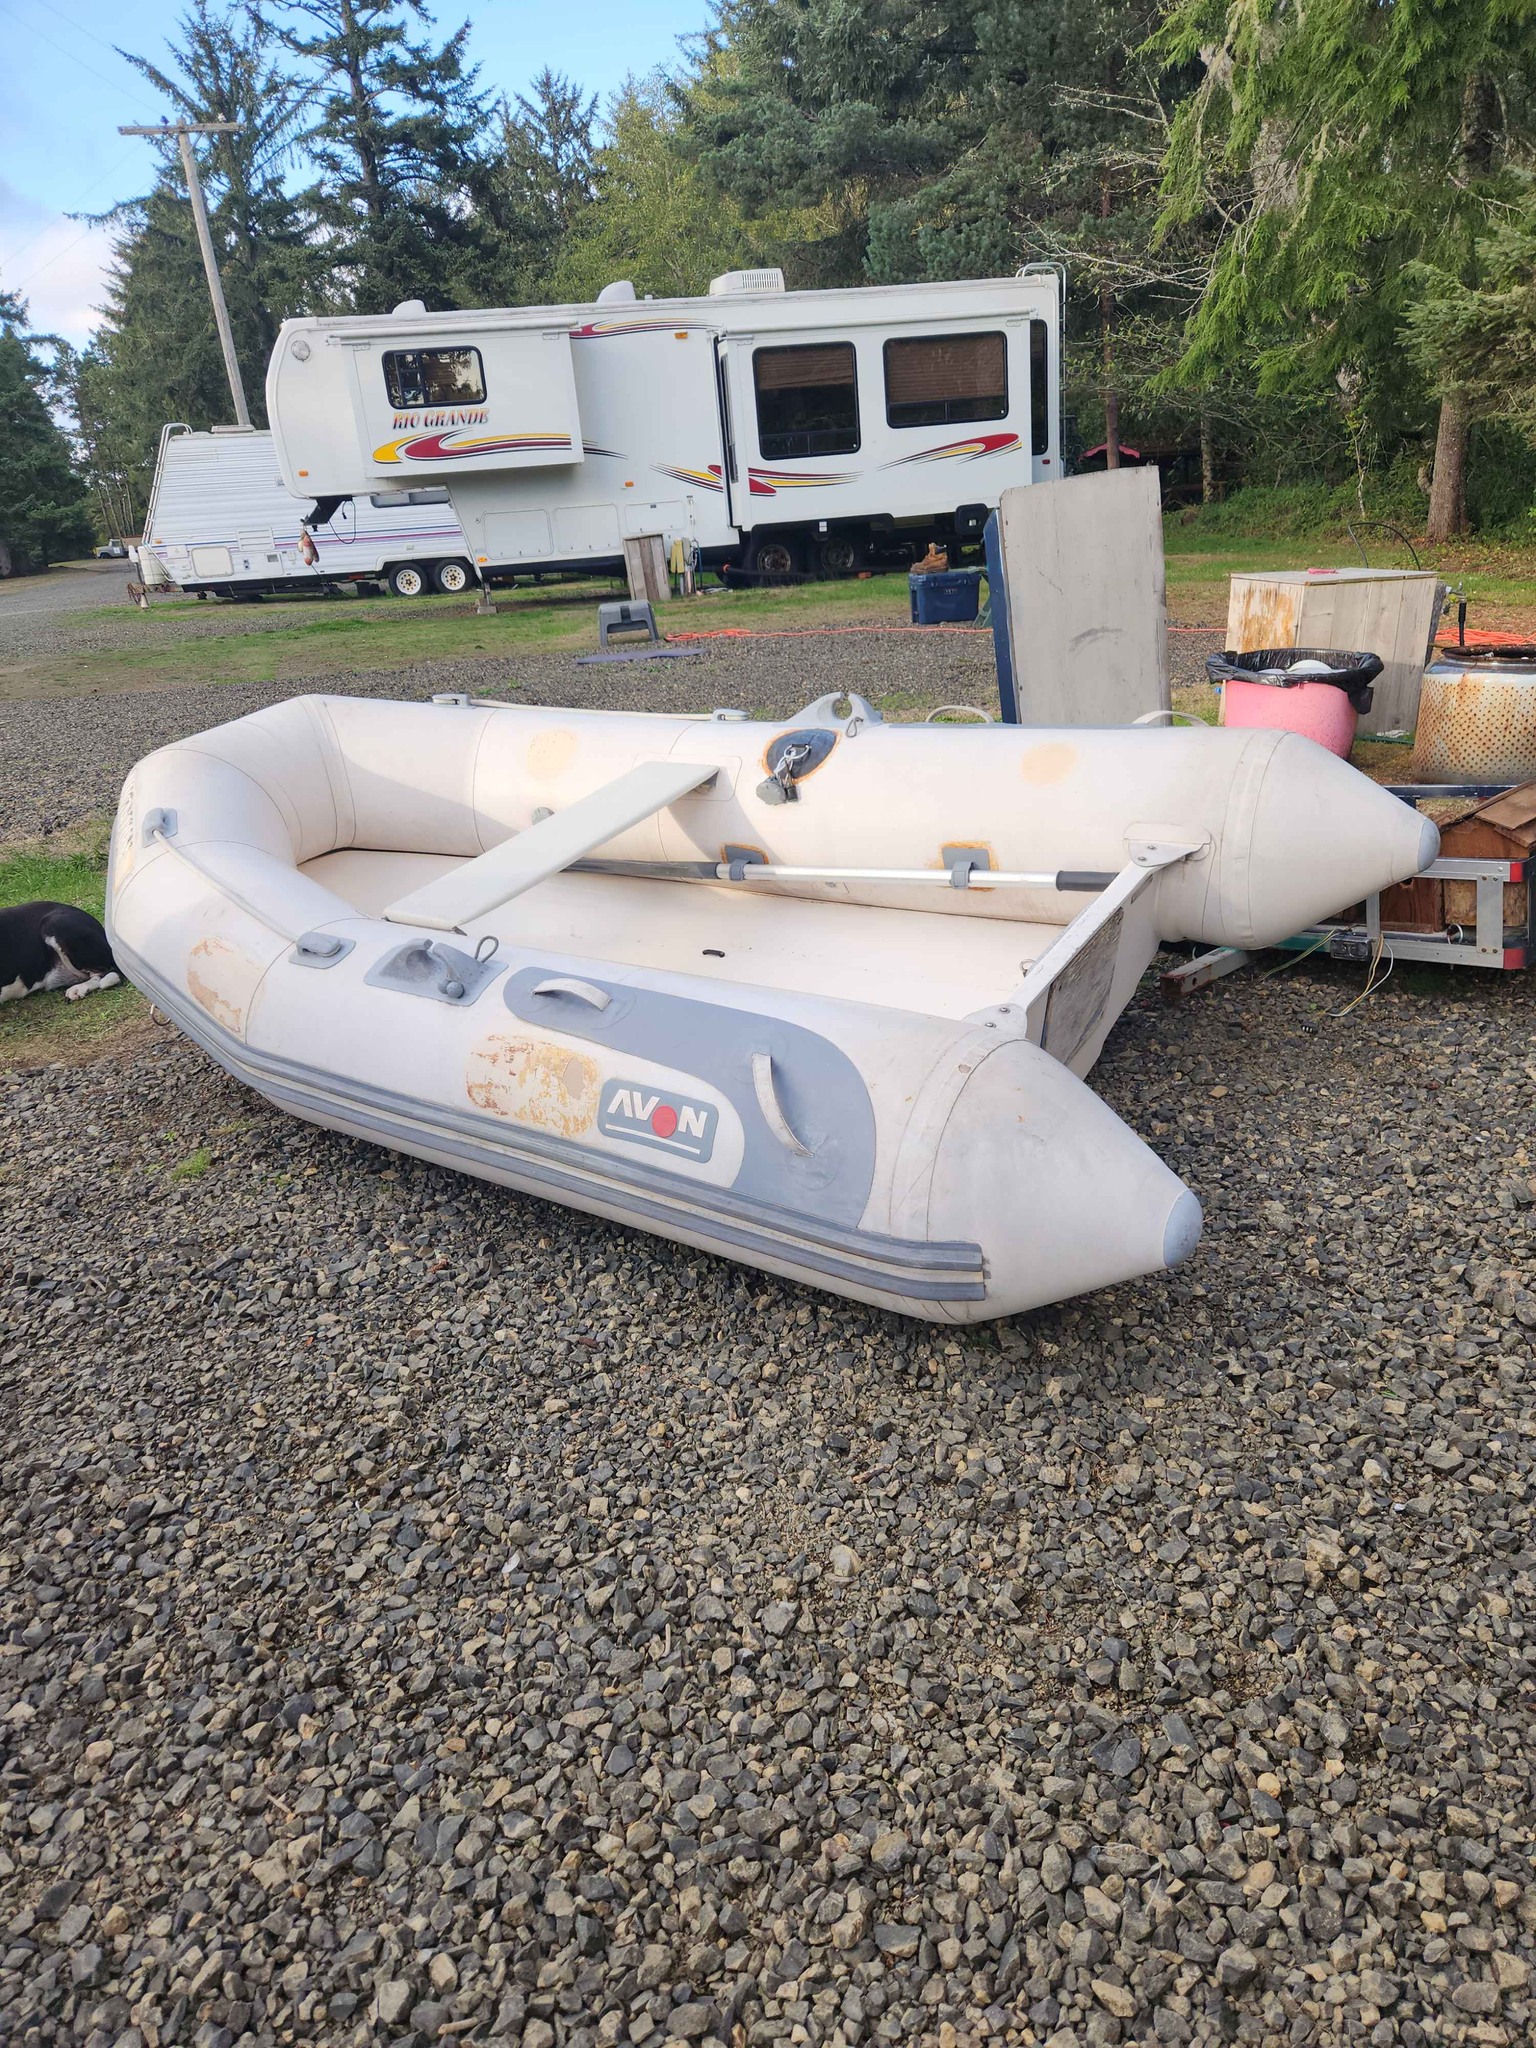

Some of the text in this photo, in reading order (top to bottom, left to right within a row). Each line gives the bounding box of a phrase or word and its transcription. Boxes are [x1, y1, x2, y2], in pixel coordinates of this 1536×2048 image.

[393, 408, 490, 430] RIO GRANDE
[607, 1089, 708, 1139] AVON
